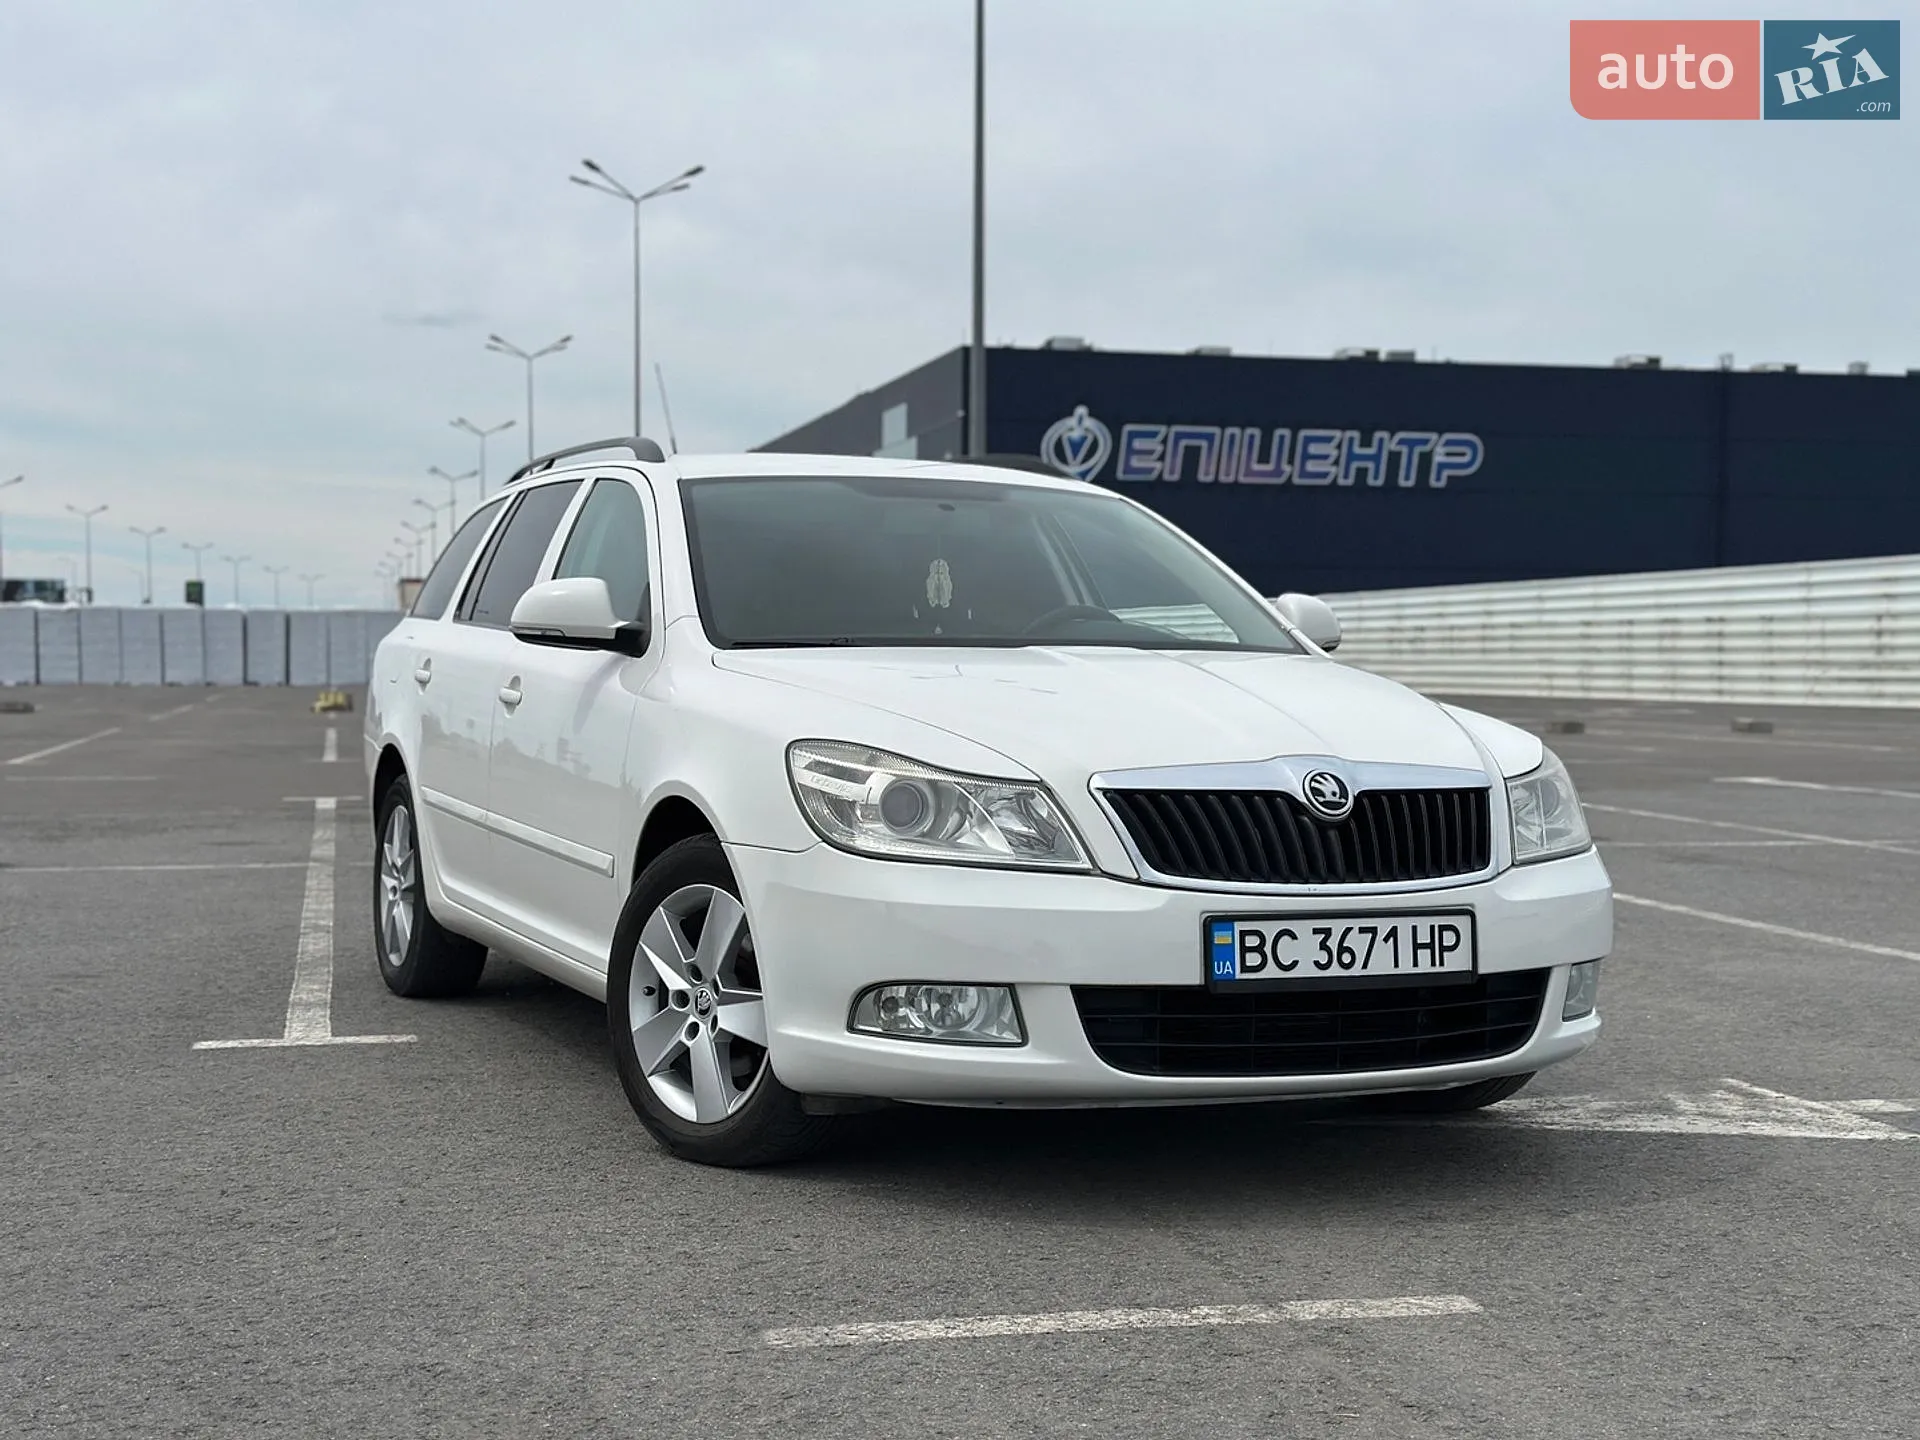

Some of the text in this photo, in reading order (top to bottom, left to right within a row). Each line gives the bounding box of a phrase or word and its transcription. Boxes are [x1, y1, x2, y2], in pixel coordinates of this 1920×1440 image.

[1116, 424, 1484, 487] ЕПІЦЕНТР
[1214, 961, 1233, 975] UA
[1238, 923, 1461, 974] BC 3671 HP
